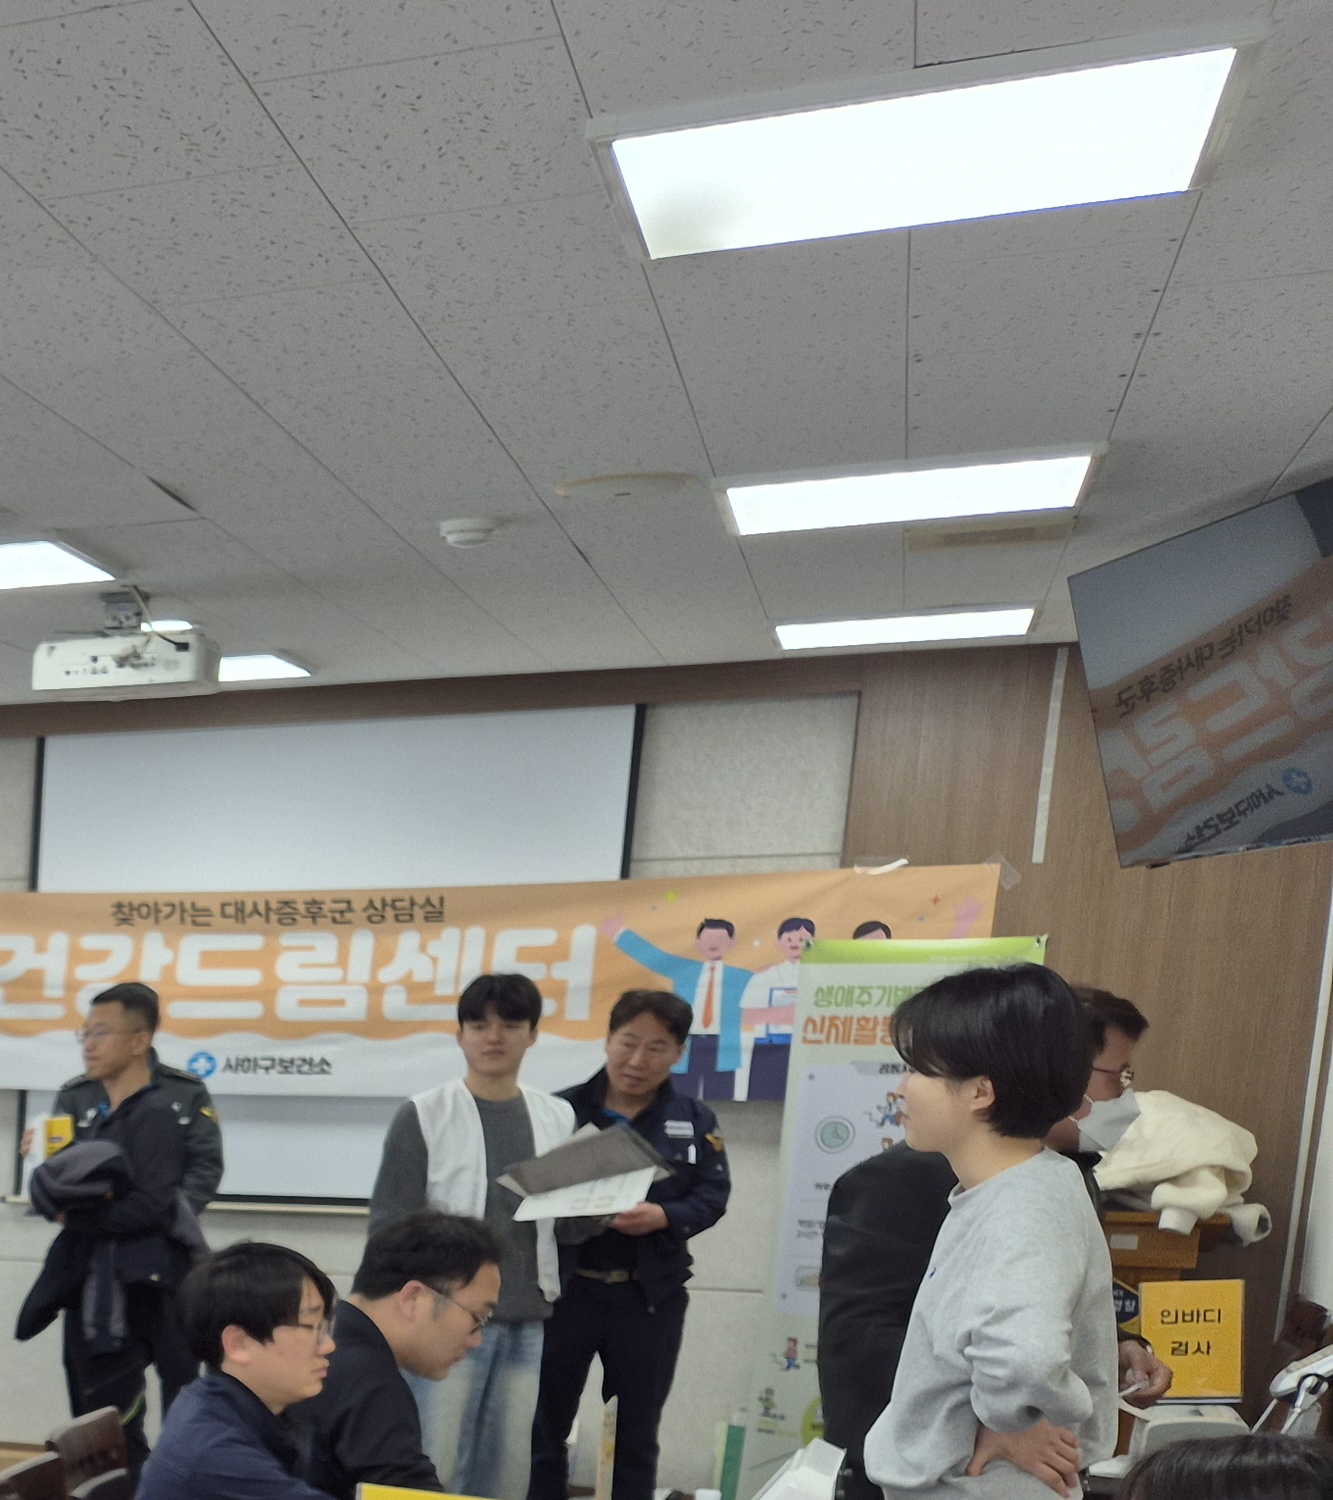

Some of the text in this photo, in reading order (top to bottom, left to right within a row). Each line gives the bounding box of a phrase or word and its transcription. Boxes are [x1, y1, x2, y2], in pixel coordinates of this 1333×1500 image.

[110, 894, 446, 929] 찾아가는 대사증후군 상담실
[221, 1054, 332, 1077] 사하구보건소
[1160, 1308, 1222, 1326] 인바디
[1171, 1340, 1211, 1357] 검사
